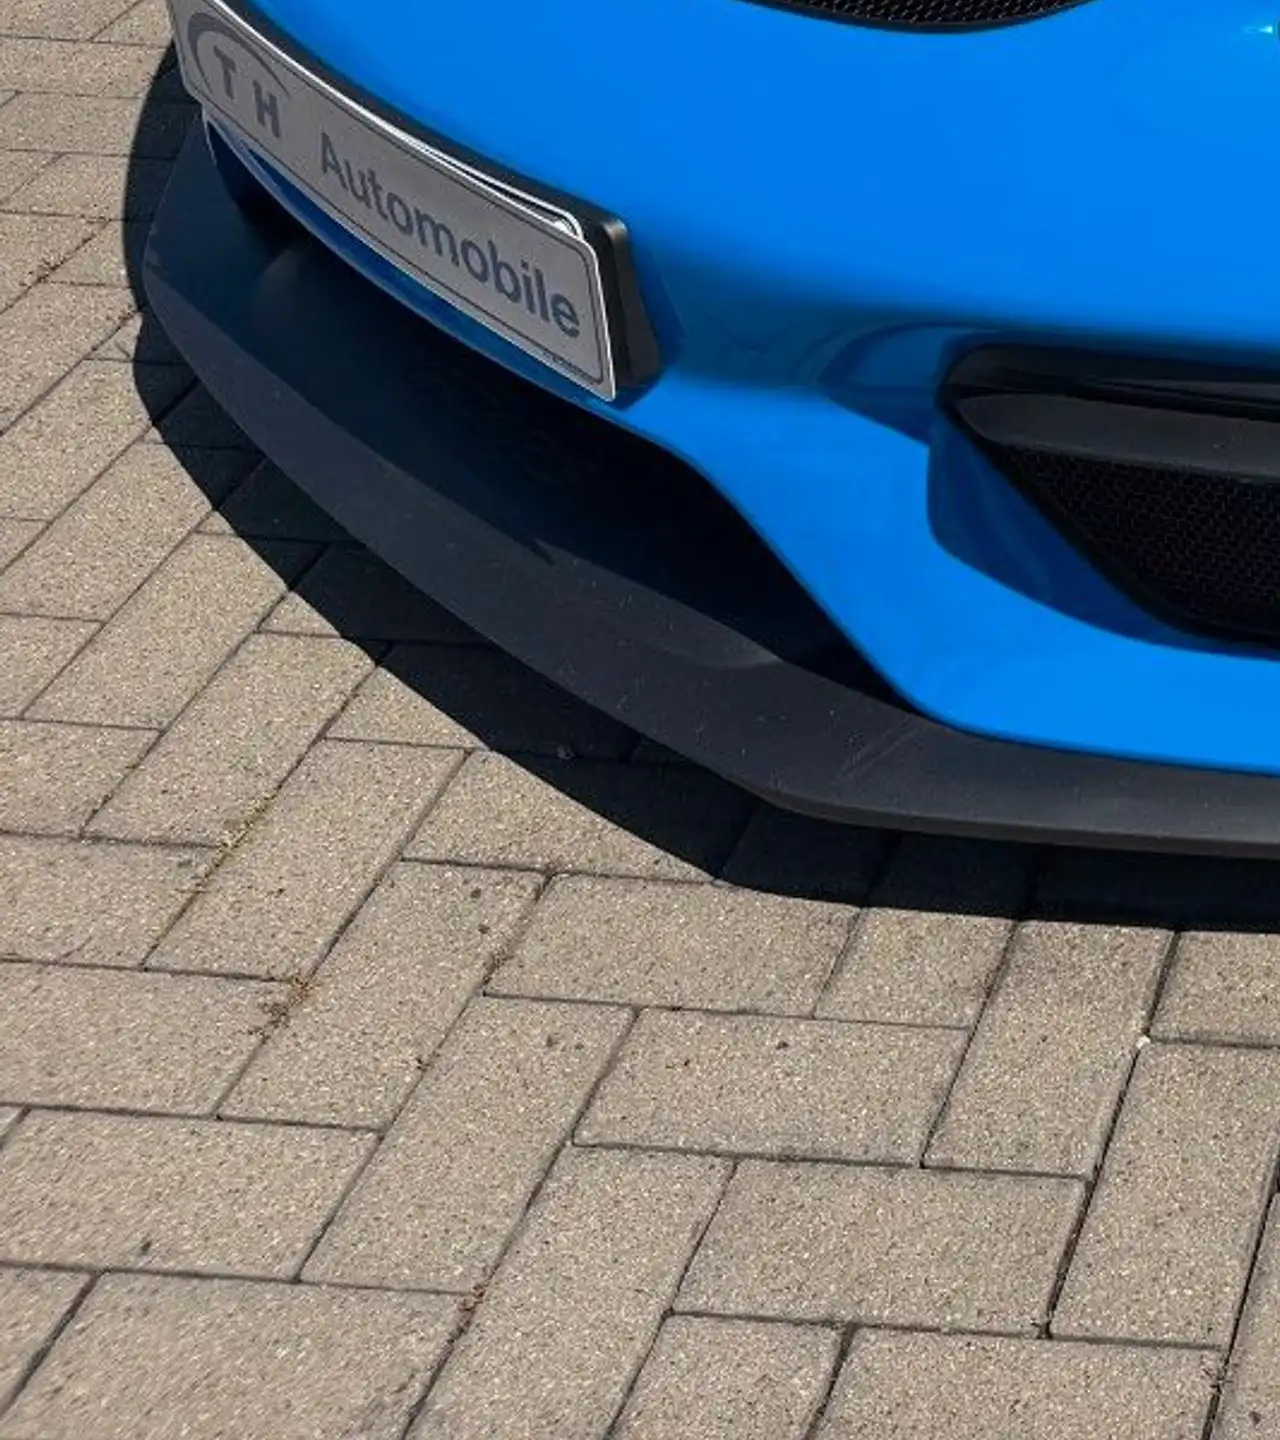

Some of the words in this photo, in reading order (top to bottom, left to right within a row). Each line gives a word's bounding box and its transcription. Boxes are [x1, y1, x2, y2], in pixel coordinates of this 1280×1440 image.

[213, 45, 236, 101] T
[252, 79, 280, 138] H
[320, 131, 580, 339] Automobile
